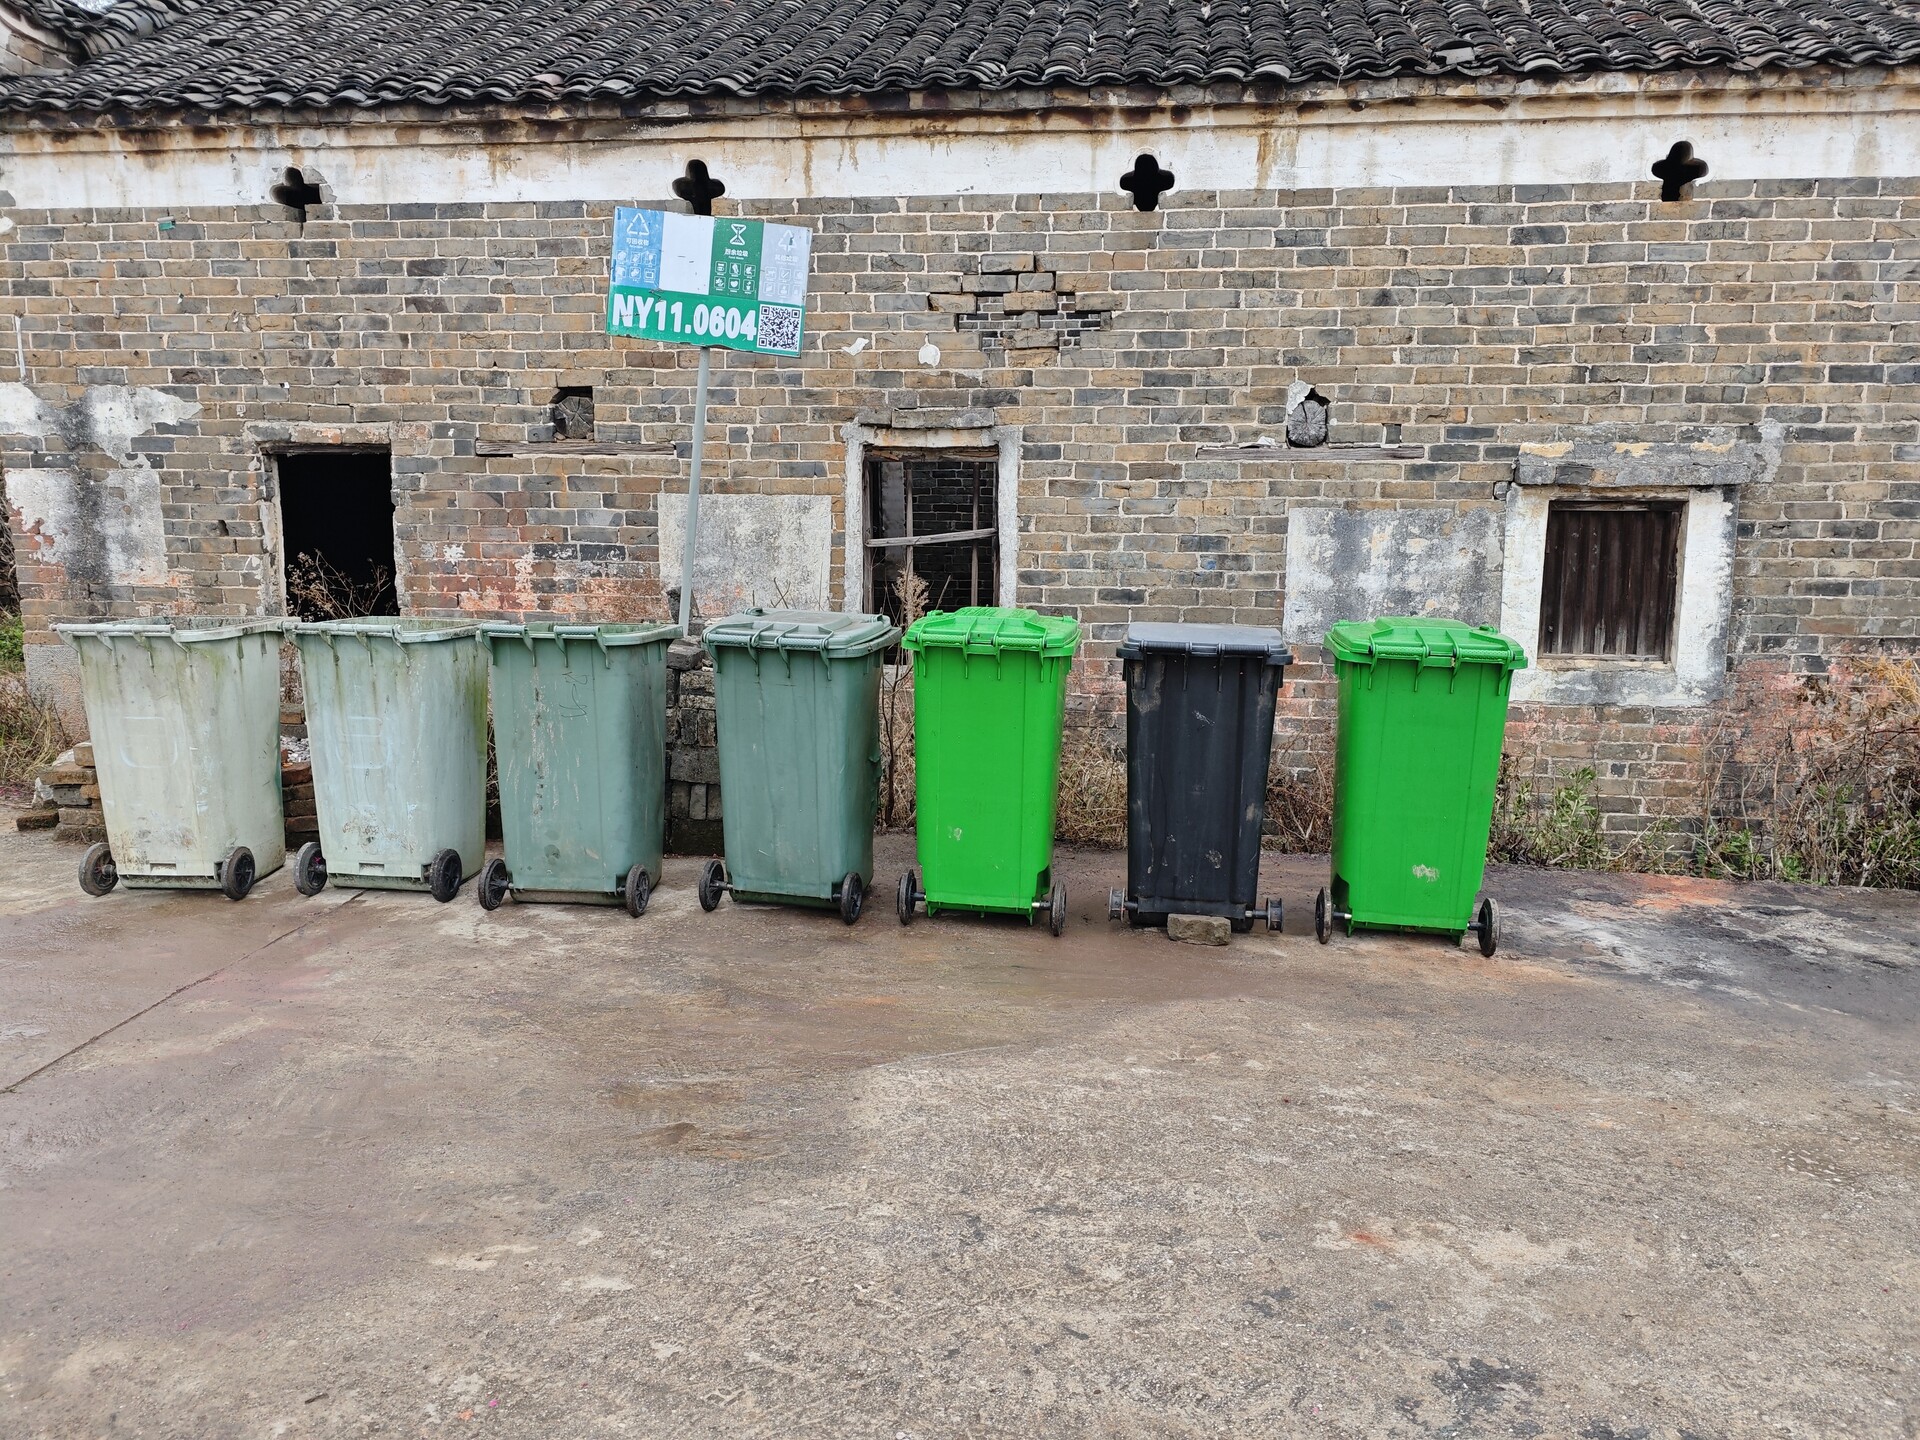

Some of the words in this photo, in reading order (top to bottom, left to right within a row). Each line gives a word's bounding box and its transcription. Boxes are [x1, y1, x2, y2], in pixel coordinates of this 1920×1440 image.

[626, 237, 649, 246] 可回收物
[724, 248, 749, 257] 厨余垃圾
[775, 254, 799, 263] 其他垃圾
[612, 293, 757, 341] NY11.0604
